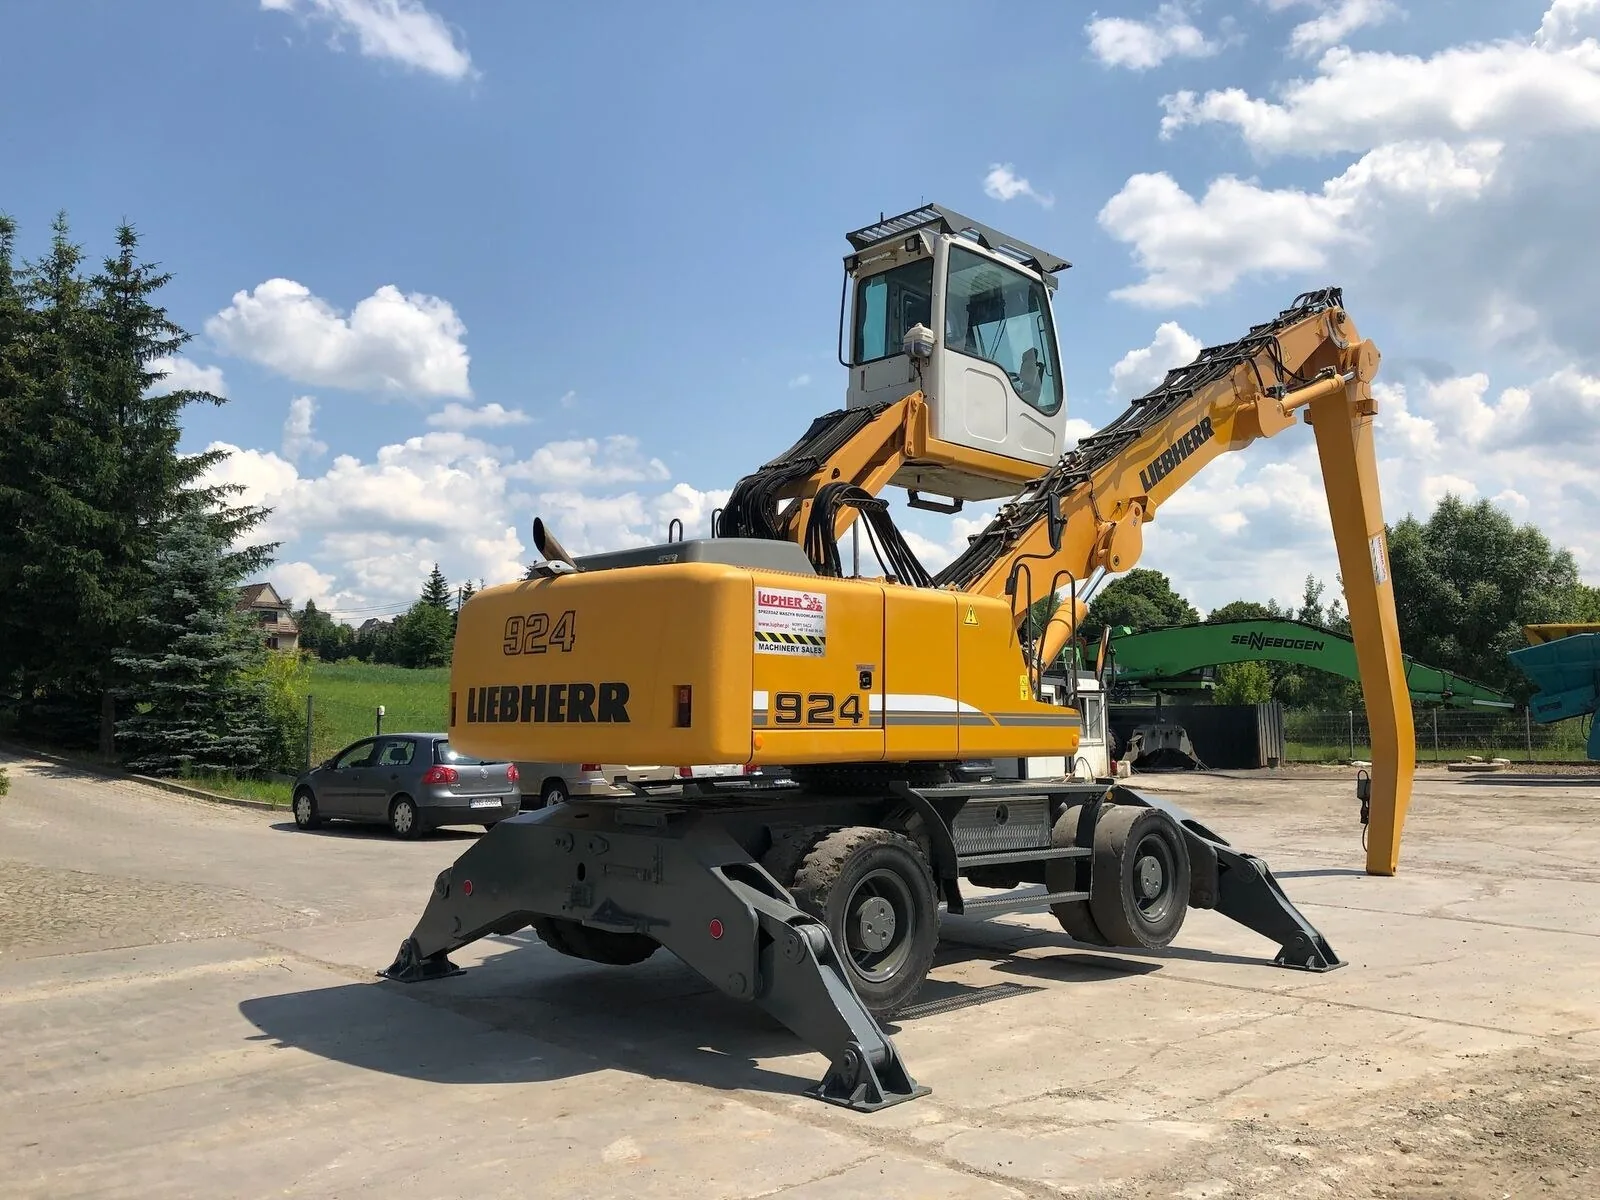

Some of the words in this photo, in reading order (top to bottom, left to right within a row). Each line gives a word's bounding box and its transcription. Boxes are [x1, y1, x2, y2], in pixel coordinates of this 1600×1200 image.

[1139, 416, 1215, 494] LIEBHERR
[758, 591, 803, 609] LUPHER
[503, 610, 576, 656] 924
[758, 643, 800, 653] MACHINERY
[801, 646, 823, 654] SALES
[1230, 631, 1325, 651] SENNEBOGEN
[466, 682, 631, 723] LIEBHERR
[775, 692, 864, 725] 924
